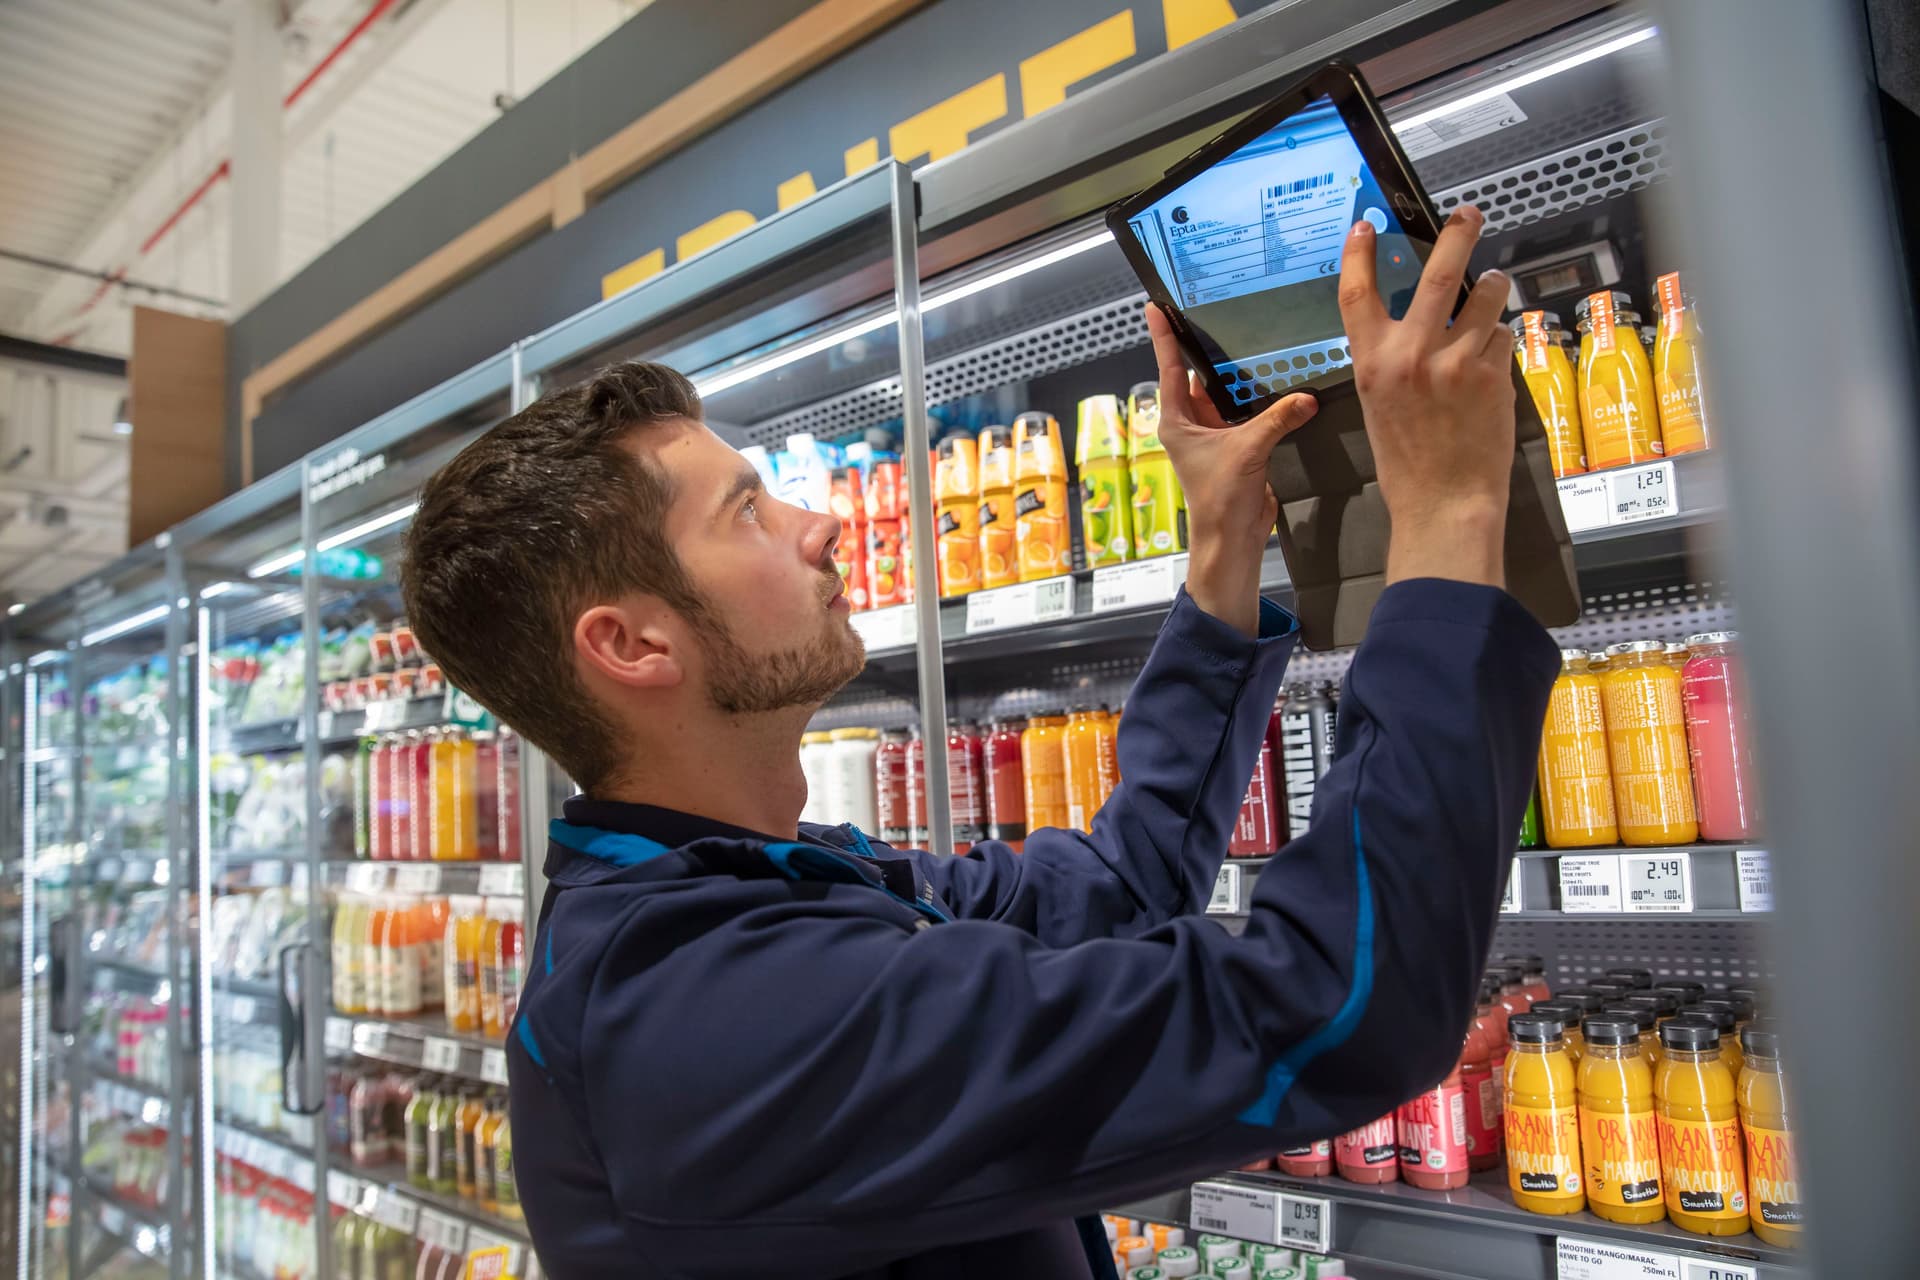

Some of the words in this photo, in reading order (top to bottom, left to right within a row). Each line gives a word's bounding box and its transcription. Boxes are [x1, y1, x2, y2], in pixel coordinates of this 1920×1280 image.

[1169, 223, 1197, 238] Epta
[1594, 401, 1638, 420] CHIA
[1558, 483, 1578, 492] ANGE
[1638, 470, 1663, 490] 1.29
[1572, 487, 1593, 496] 250ml
[1588, 686, 1602, 732] Zucker!
[1280, 713, 1315, 842] VANILLE
[1648, 861, 1678, 880] 2.49
[1598, 1116, 1656, 1144] ORANG
[1660, 1122, 1732, 1153] ORANGE
[1602, 1139, 1656, 1162] MANG
[1604, 1159, 1658, 1184] MARACU
[1666, 1166, 1738, 1195] MARACUJA
[1522, 1178, 1558, 1189] Smoothie
[1294, 1202, 1318, 1220] 0.99
[1682, 1198, 1722, 1208] Smoothie
[1558, 1243, 1596, 1255] SMOOTHIE
[1597, 1248, 1658, 1266] MANGO/MARAC.
[1560, 1252, 1578, 1261] REWE
[1580, 1254, 1590, 1262] TO
[1591, 1256, 1602, 1265] GO
[1642, 1266, 1666, 1276] 250ml
[1667, 1270, 1677, 1278] FL
